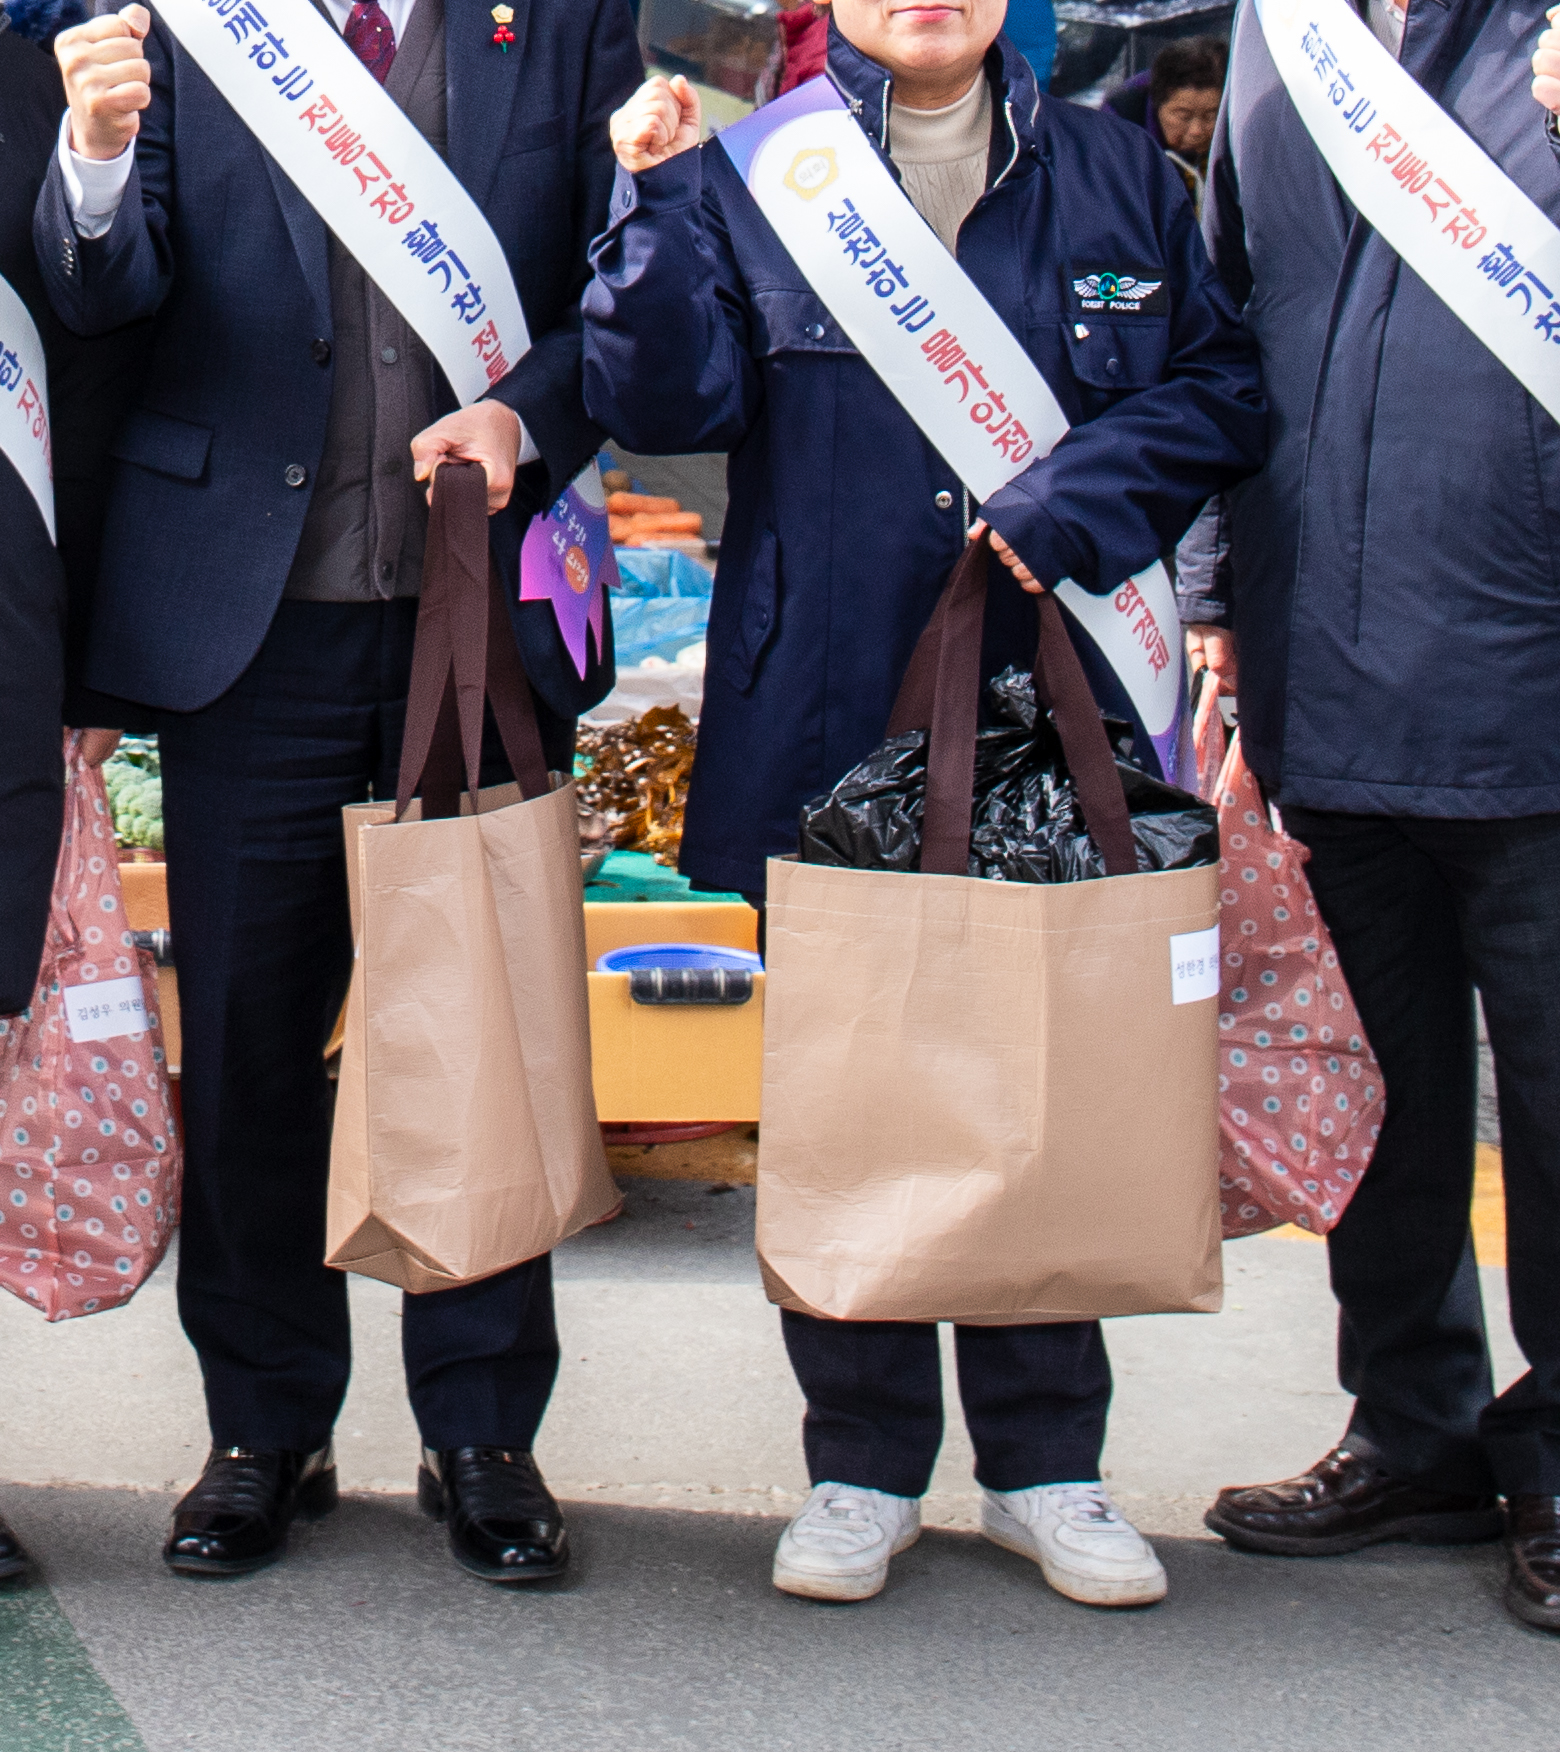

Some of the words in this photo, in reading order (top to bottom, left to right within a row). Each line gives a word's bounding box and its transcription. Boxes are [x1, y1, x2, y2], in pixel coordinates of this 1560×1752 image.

[298, 94, 415, 225] 전통시장
[401, 220, 486, 326] 활기찬
[1300, 21, 1376, 135] 함께하는
[1366, 122, 1488, 251] 전통시장
[825, 199, 937, 335] 실천하는
[921, 328, 1036, 465] 물가안정
[1109, 299, 1141, 311] POLICE
